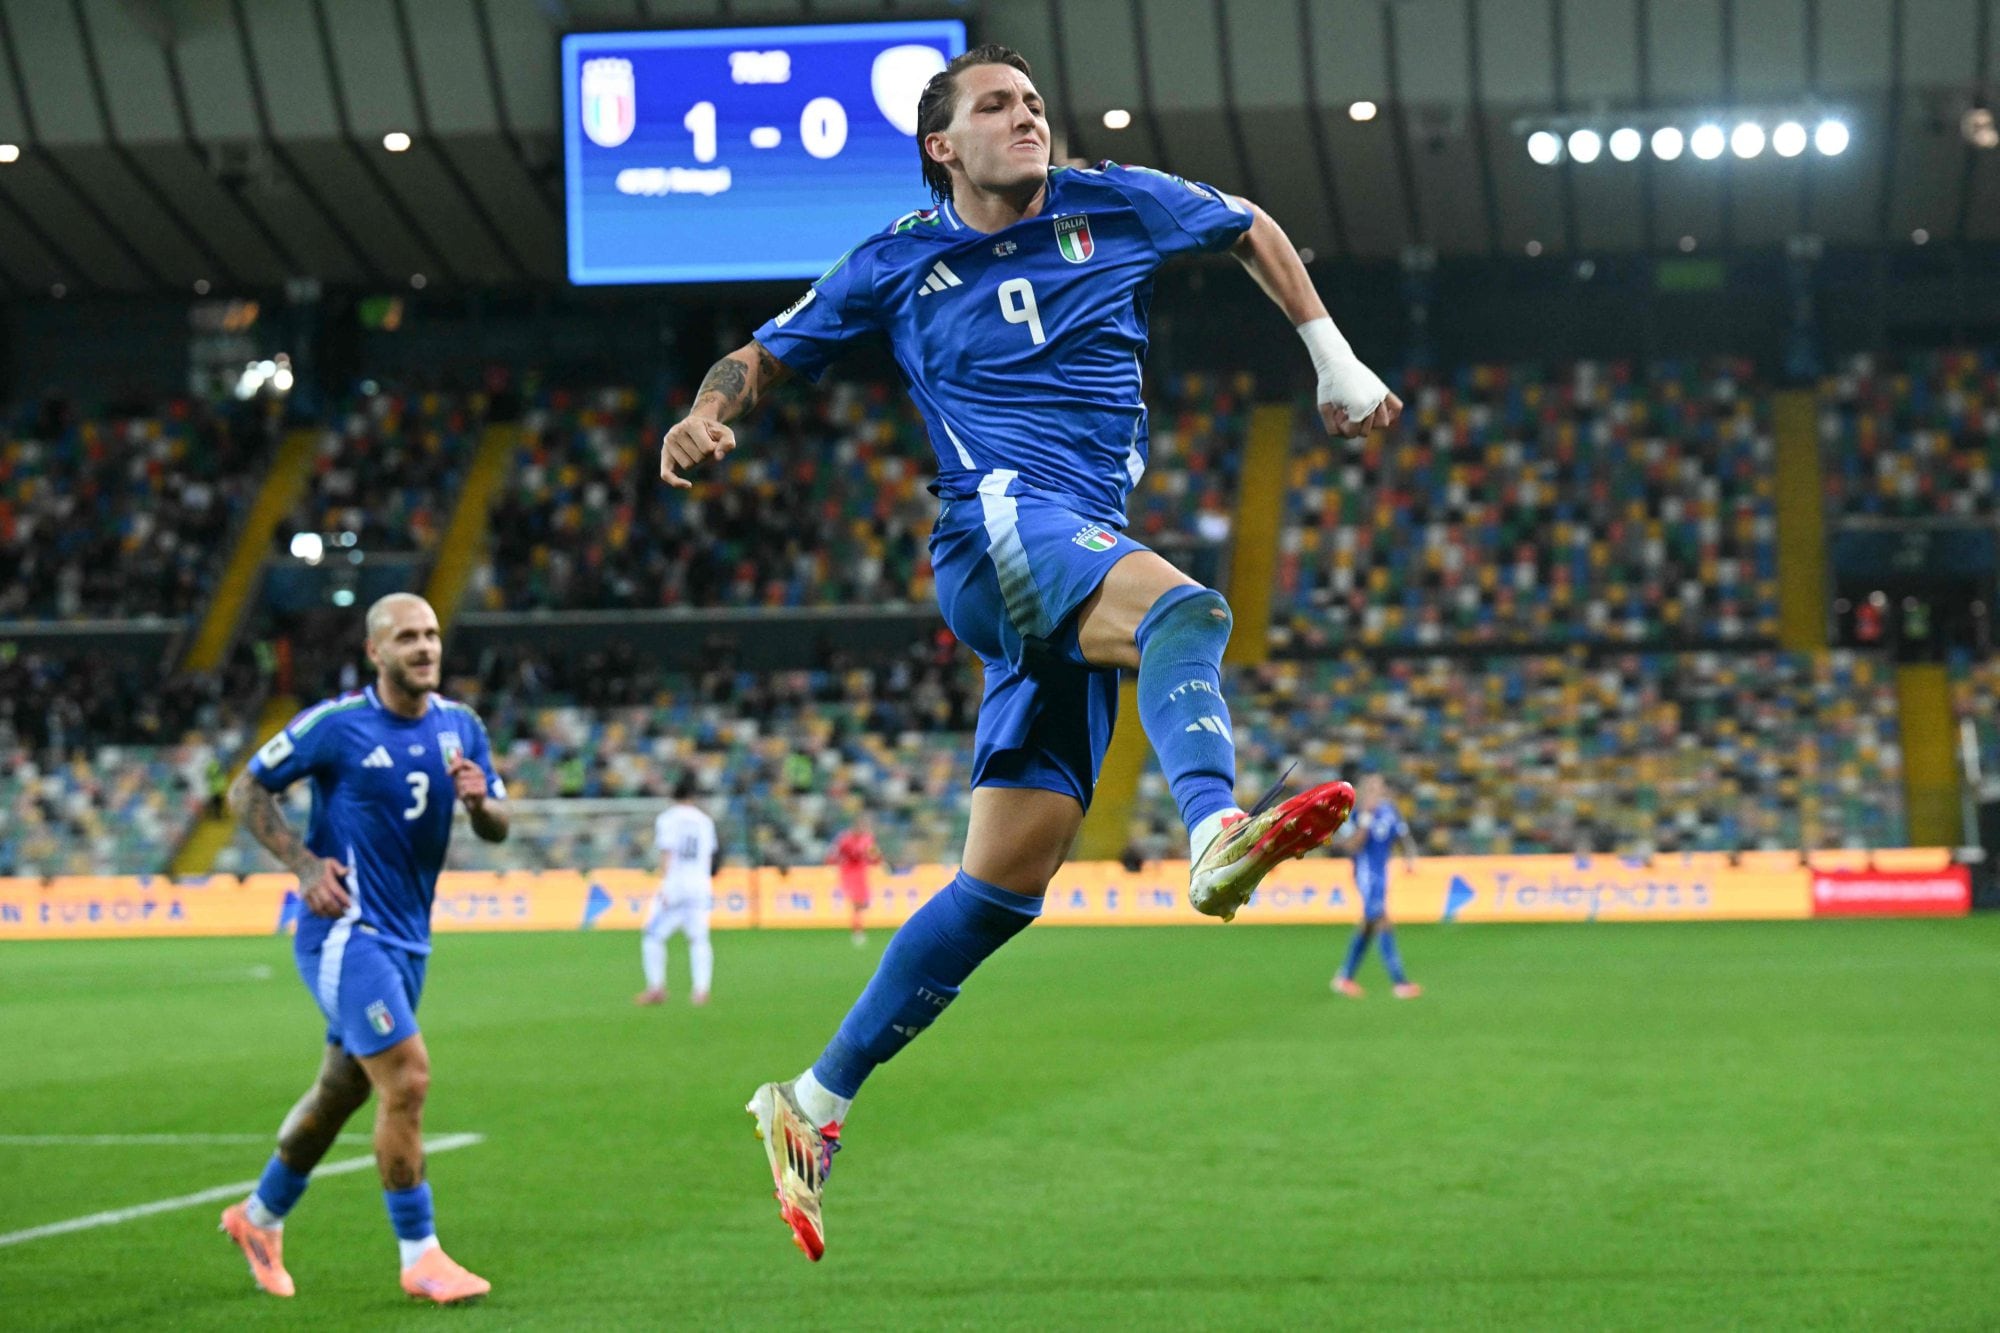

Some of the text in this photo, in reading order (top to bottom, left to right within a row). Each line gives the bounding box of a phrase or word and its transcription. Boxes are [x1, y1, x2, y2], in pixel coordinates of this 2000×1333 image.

[684, 101, 716, 162] 1
[800, 97, 848, 158] 0
[1057, 218, 1084, 231] ITALIA
[998, 277, 1046, 345] 9
[404, 771, 429, 820] 3
